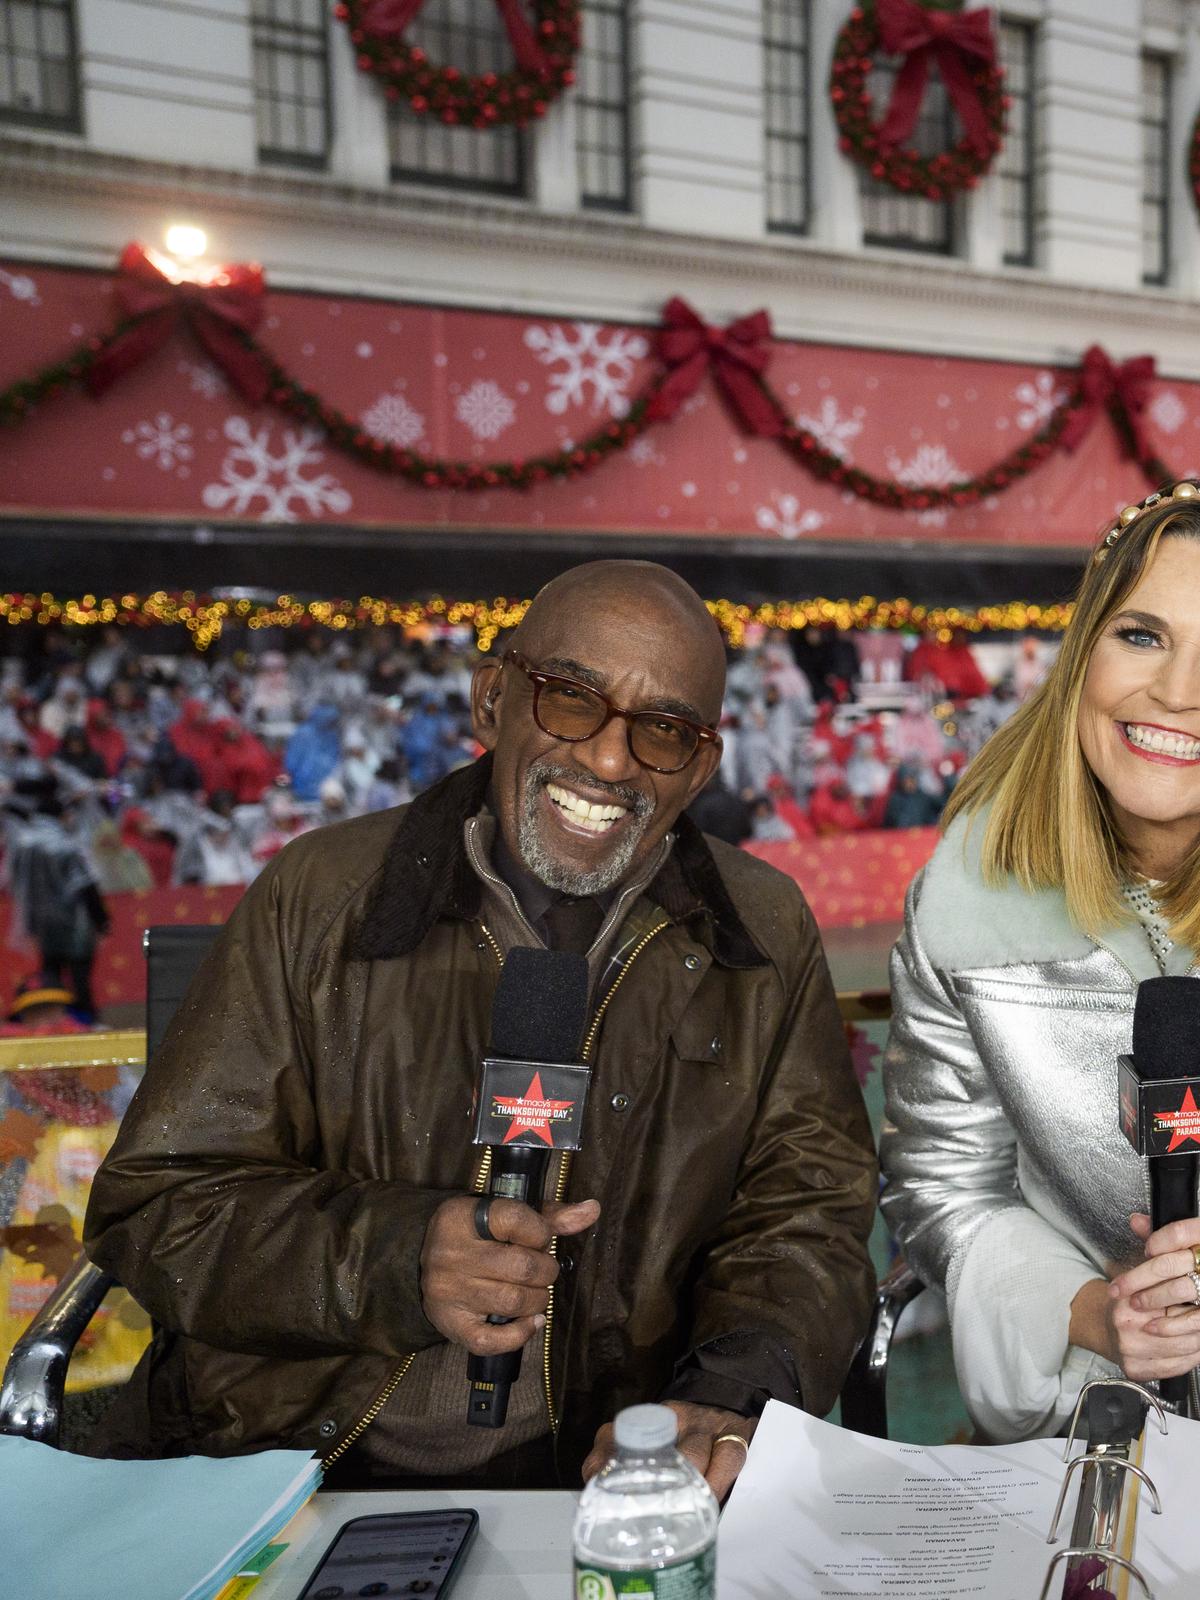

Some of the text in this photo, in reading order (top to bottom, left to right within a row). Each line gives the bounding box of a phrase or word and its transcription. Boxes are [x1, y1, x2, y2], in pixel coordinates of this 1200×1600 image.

[523, 1099, 551, 1108] macy's
[497, 1105, 568, 1119] THANKSGIVING DAY
[516, 1117, 546, 1127] PARADE
